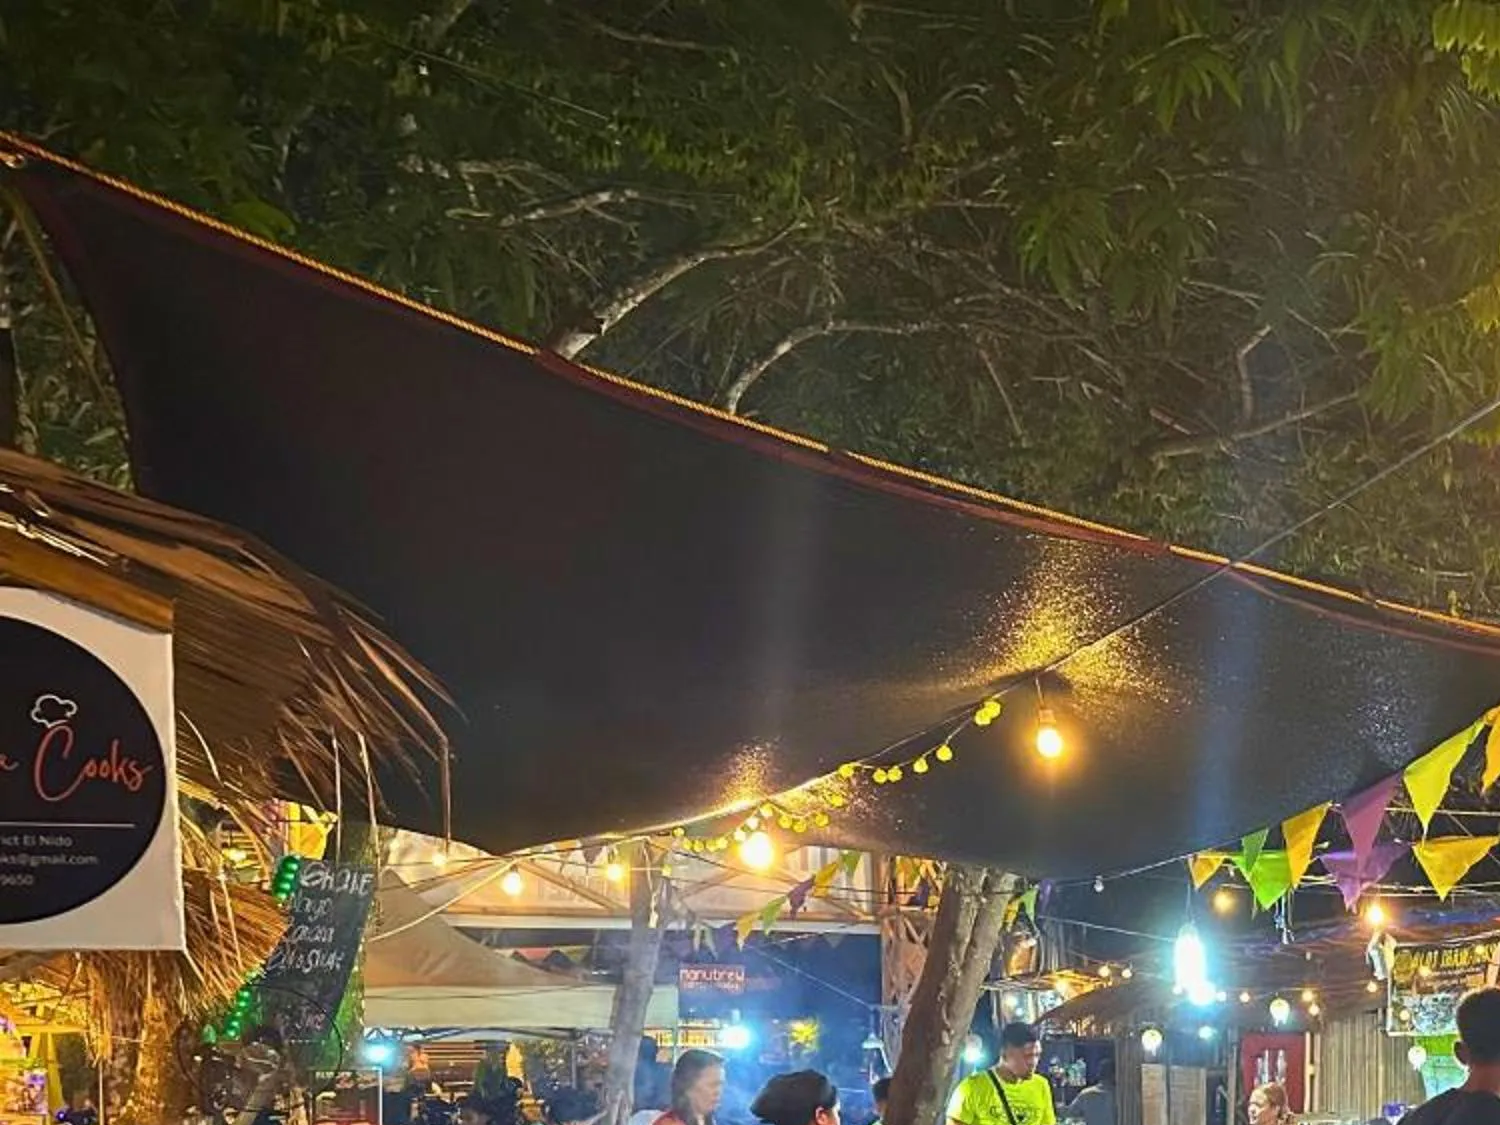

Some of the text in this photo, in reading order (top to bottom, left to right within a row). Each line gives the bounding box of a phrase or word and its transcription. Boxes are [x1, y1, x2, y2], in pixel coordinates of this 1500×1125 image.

[34, 724, 153, 801] Cooks
[23, 834, 36, 847] El
[39, 834, 73, 848] Nido
